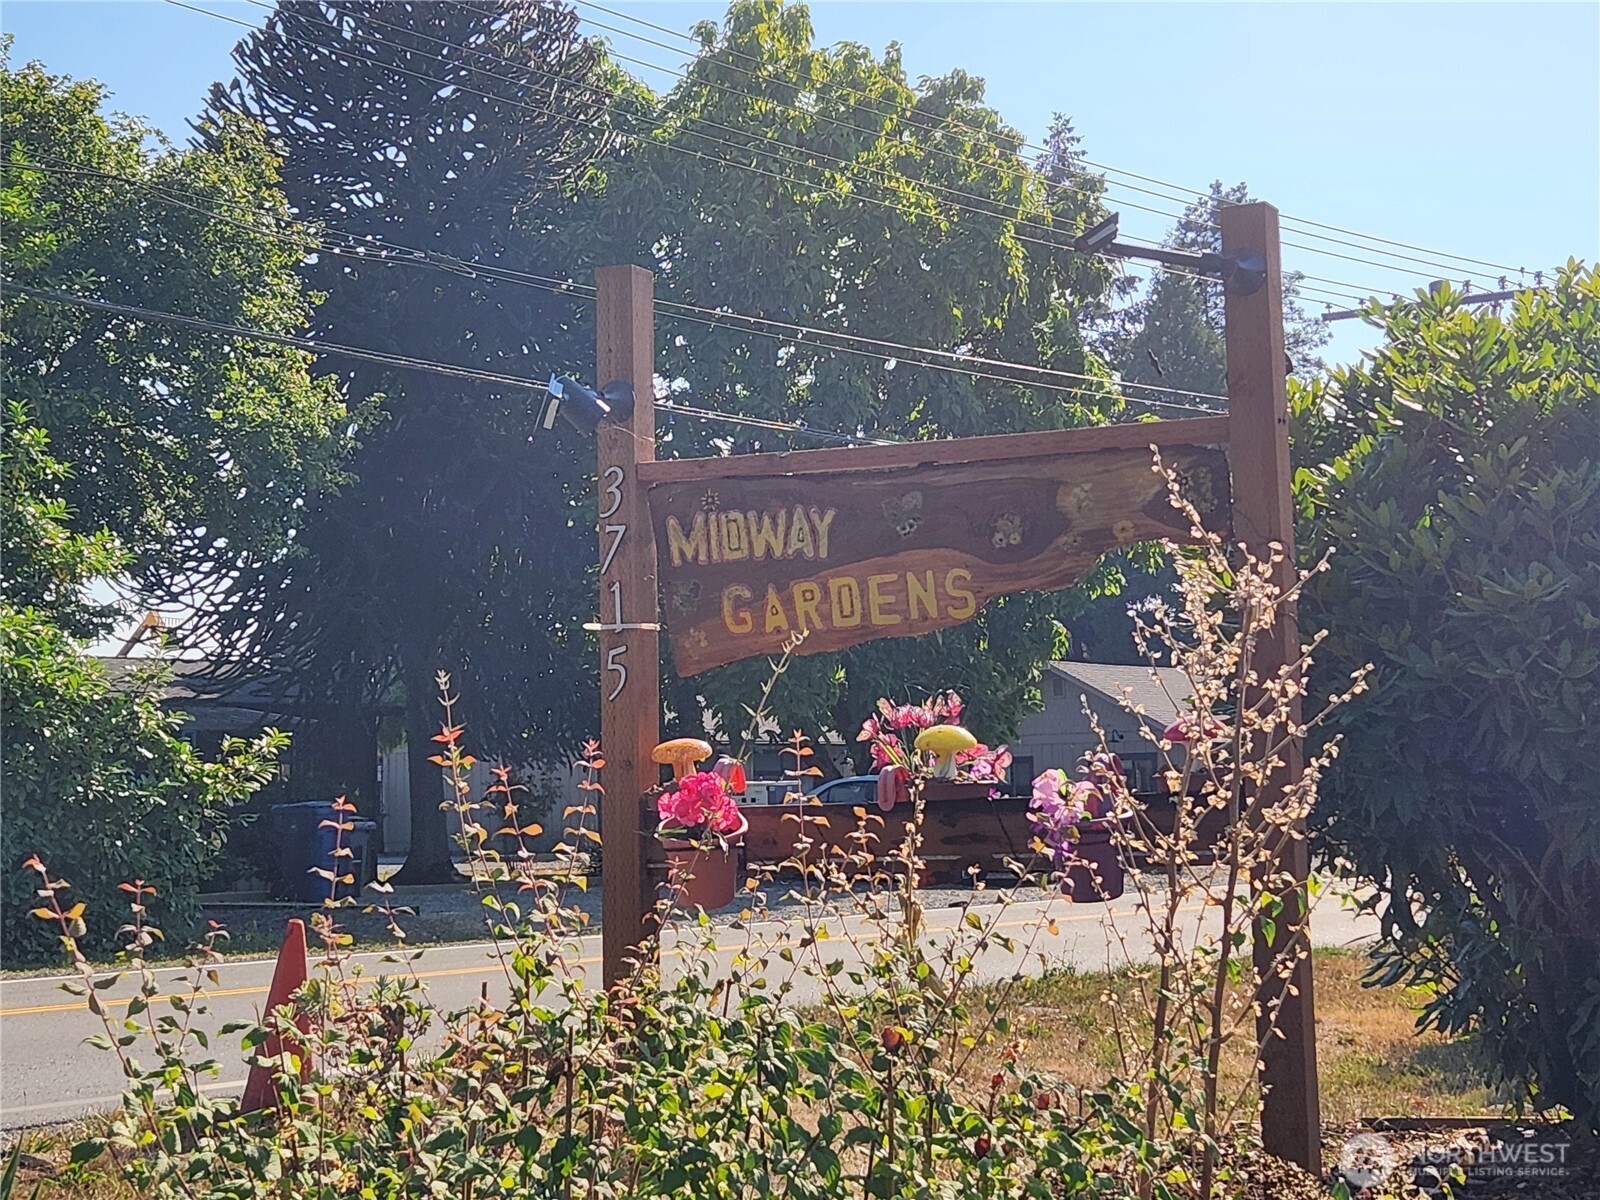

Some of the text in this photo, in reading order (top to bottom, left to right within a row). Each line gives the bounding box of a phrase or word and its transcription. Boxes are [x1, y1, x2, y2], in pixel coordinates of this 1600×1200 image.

[667, 505, 837, 567] MIDWAY
[600, 465, 627, 701] 3715
[723, 567, 977, 635] GARDENS
